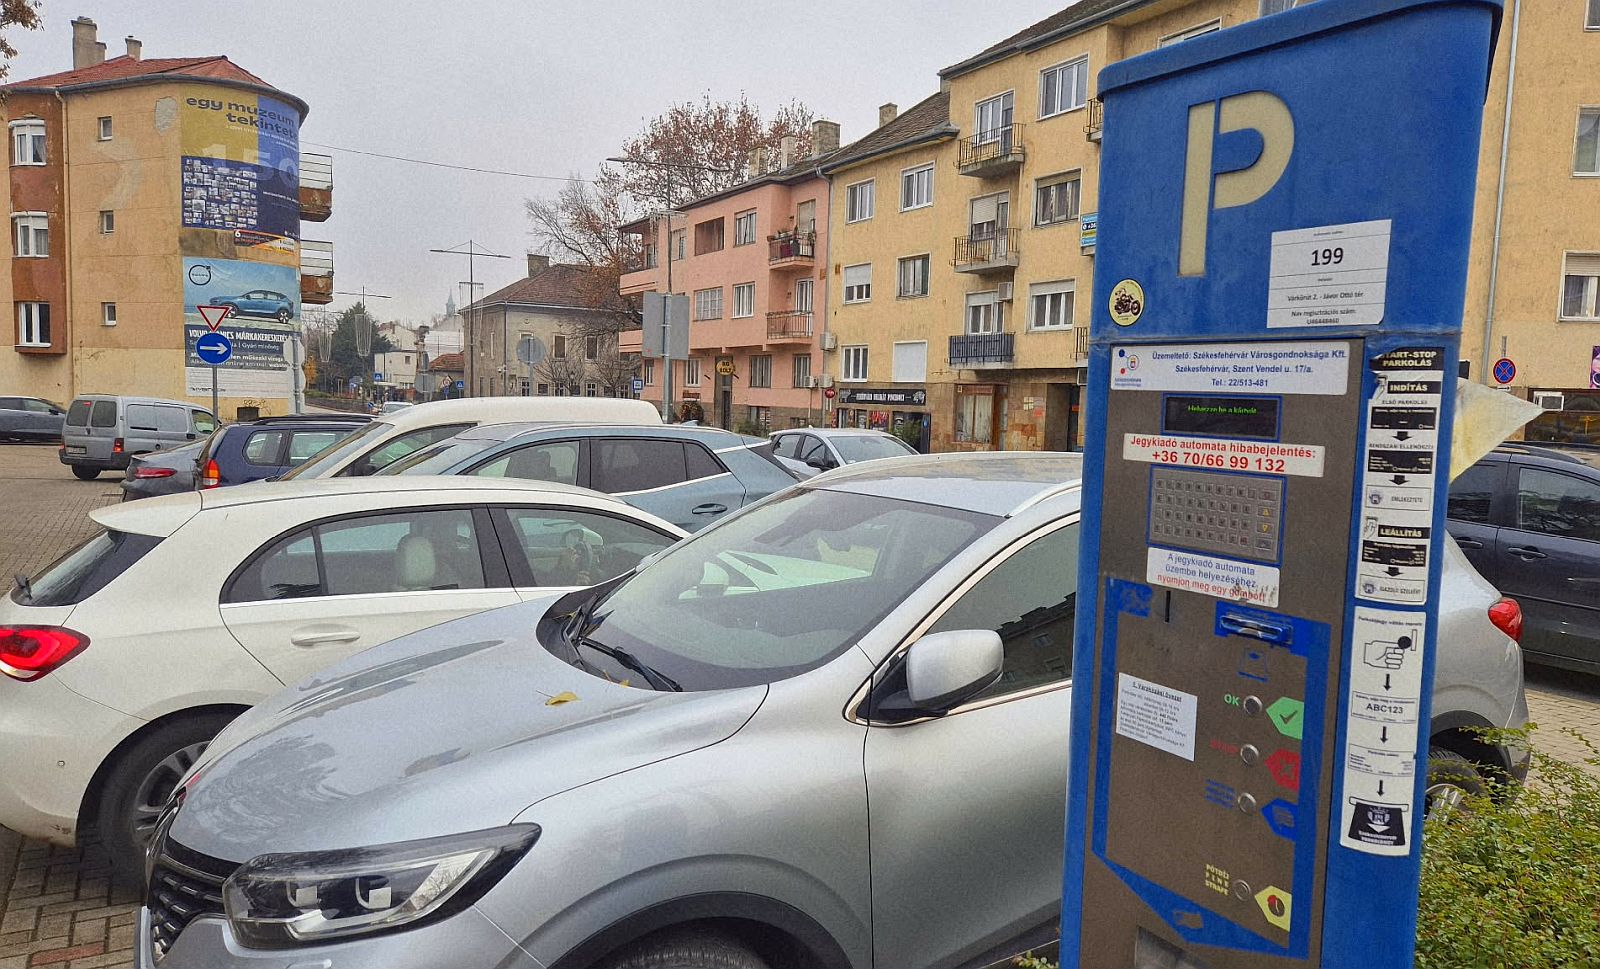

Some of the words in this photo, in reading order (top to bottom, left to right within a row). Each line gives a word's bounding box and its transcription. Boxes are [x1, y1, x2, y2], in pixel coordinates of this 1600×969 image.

[186, 97, 223, 111] egy
[202, 144, 299, 187] 150
[1177, 90, 1295, 277] P
[1311, 247, 1344, 266] 199
[1193, 350, 1248, 360] Székesfehérvár
[1250, 350, 1329, 360] Városgondnoksága
[1175, 364, 1230, 374] Székesfehérvár,
[1233, 364, 1254, 373] Szent
[1255, 364, 1282, 373] Vendel
[1383, 359, 1432, 367] PARKOLÁS
[1228, 378, 1268, 387] 22/513-481
[1390, 383, 1428, 392] INDÍTÁS
[1131, 436, 1177, 449] Jegykiadó
[1180, 440, 1227, 452] automata
[1230, 444, 1316, 459] hibabejelentés:
[1152, 451, 1178, 463] +36
[1183, 452, 1224, 467] 70/66
[1230, 456, 1249, 470] 99
[1255, 458, 1285, 473] 132
[1380, 528, 1422, 537] LEÁLLÍTÁS
[1165, 564, 1196, 577] üzembe
[1167, 553, 1174, 561] A
[1174, 555, 1213, 568] jegykiadó
[1215, 561, 1255, 576] automata
[1157, 574, 1190, 587] nyomjon
[1192, 581, 1210, 590] meg
[1211, 585, 1227, 595] egy
[1223, 694, 1240, 706] OK
[1366, 703, 1403, 714] ABC123
